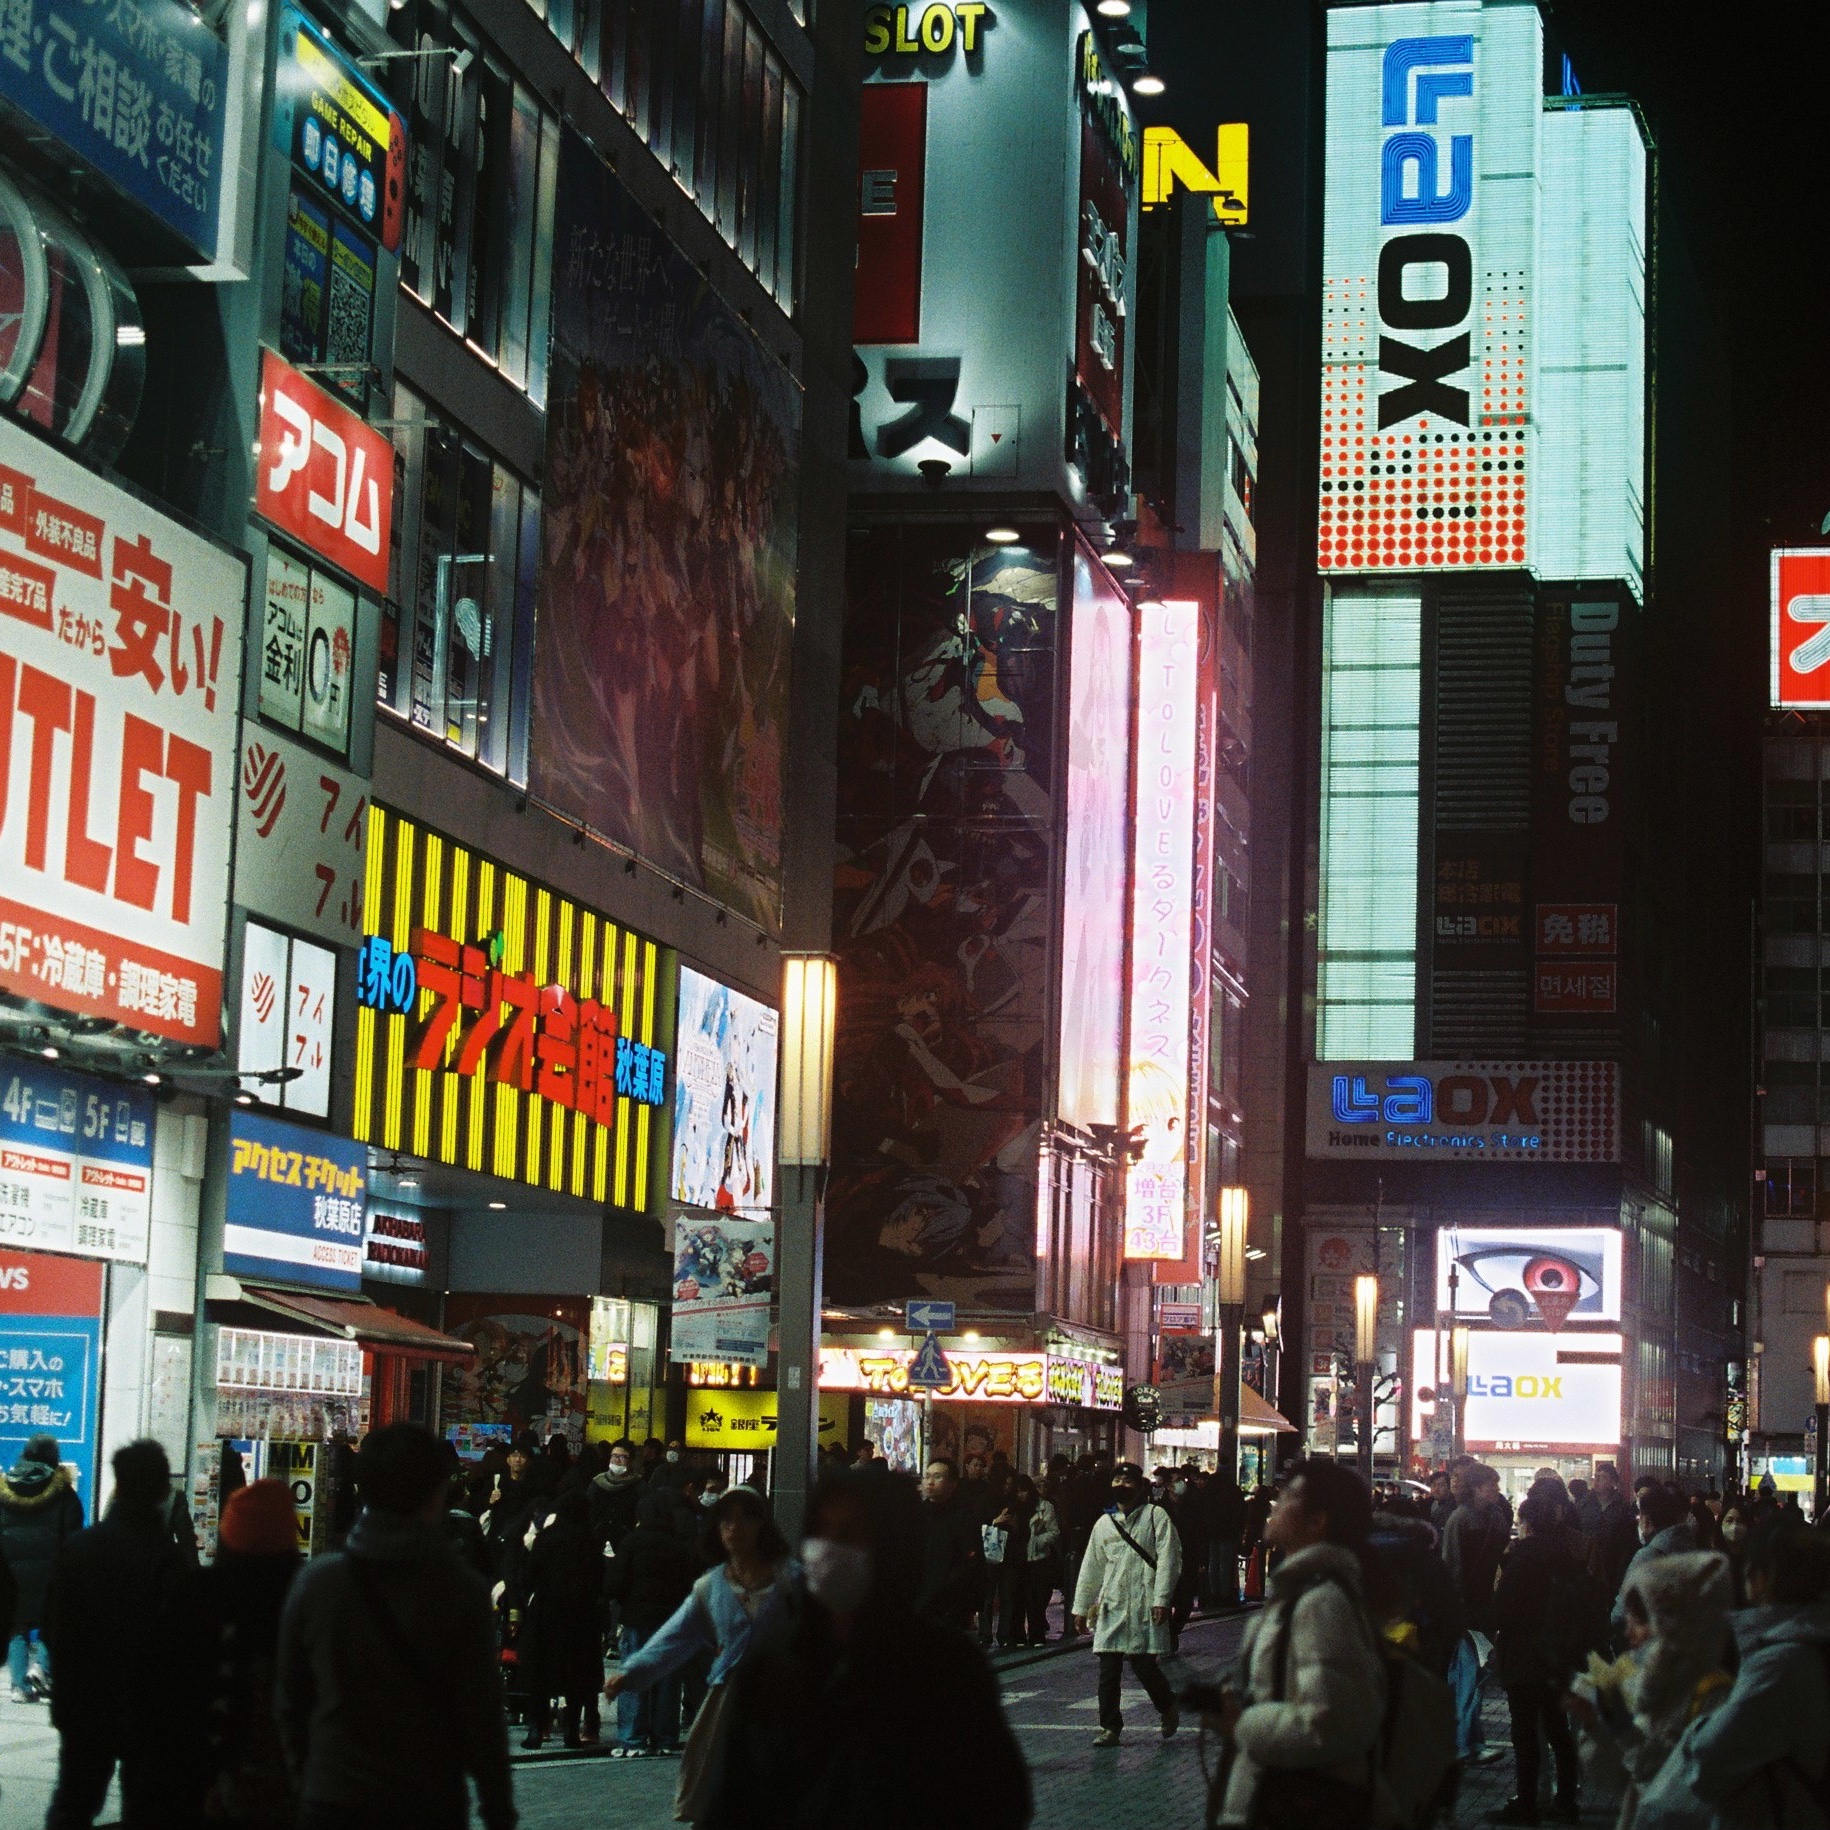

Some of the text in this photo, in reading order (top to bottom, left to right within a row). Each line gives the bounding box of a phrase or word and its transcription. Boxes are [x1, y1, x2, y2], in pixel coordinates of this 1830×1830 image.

[865, 3, 985, 54] SLOT
[157, 102, 212, 177] お任せ
[312, 91, 338, 130] GAME
[340, 116, 373, 163] REPAIR
[156, 155, 208, 213] ください
[862, 170, 898, 216] E
[1142, 123, 1249, 226] N
[270, 389, 381, 556] アコム
[35, 510, 97, 561] 外装不良品
[59, 604, 106, 656] だから
[108, 533, 224, 714] 安い!
[1565, 602, 1619, 824] Duty Free
[1540, 975, 1611, 1000] 면세점
[615, 1036, 666, 1105] 秋葉原
[4, 1077, 110, 1140] 4F 5F
[1329, 1131, 1541, 1149] Home Electronics Store
[232, 1138, 364, 1198] アクセスチケット
[1135, 1178, 1178, 1199] 増台
[314, 1195, 363, 1236] 秋葉原店
[1143, 1205, 1170, 1224] 3F
[313, 1245, 337, 1264] ACCESS
[338, 1247, 359, 1267] TICKET
[1129, 1230, 1181, 1252] 43台
[0, 1378, 64, 1398] ・スマホ
